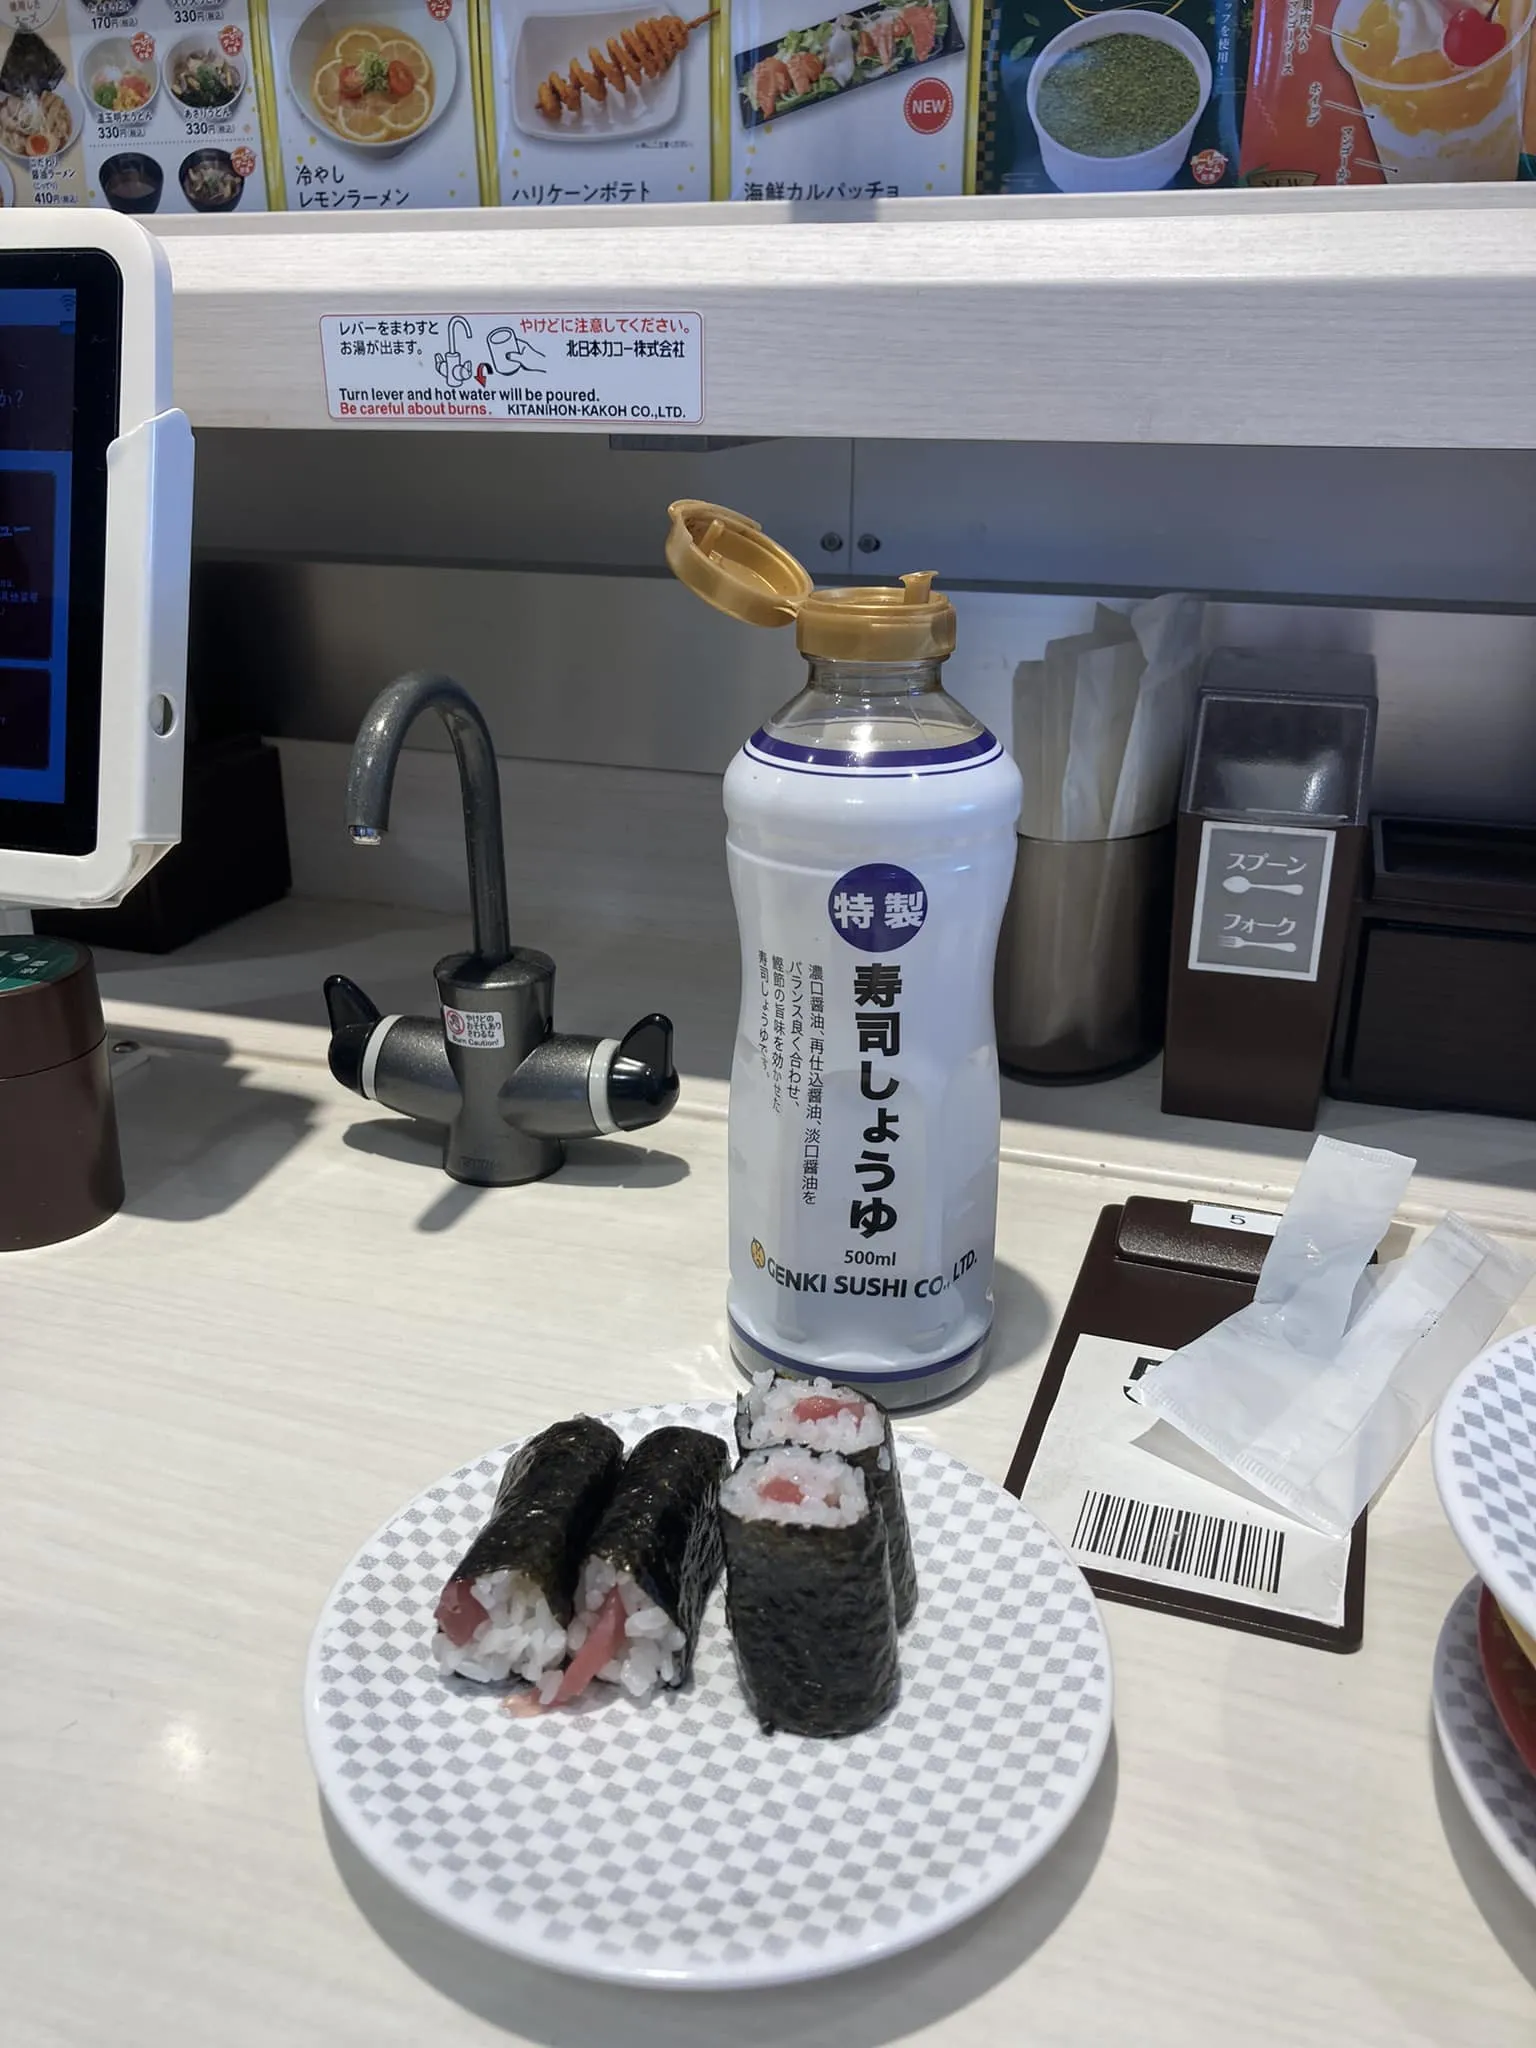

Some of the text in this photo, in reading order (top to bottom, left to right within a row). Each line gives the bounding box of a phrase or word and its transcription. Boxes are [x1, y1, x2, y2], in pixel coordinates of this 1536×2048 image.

[912, 100, 946, 115] NEW
[296, 164, 345, 187] 冷やし
[300, 188, 410, 209] レモンラーメン
[512, 180, 650, 206] ハリケーンポテト
[744, 180, 900, 201] 海鮮カルパッチョ
[339, 320, 440, 336] レバーをまわすと
[519, 317, 690, 334] やけどに注意してください。
[340, 339, 423, 356] お湯が出ます。
[566, 339, 685, 358] 北日本カコー株式会社
[339, 387, 600, 403] Turn lever and hot water will be poured.
[340, 402, 492, 416] Be careful about burns.
[507, 403, 627, 417] KITANIHON-KAKOH
[1226, 852, 1307, 876] スプーン
[833, 891, 924, 929] 特製
[1223, 913, 1297, 936] フォーク
[786, 960, 803, 1108] バランス良く合わせ、
[850, 963, 902, 1239] 寿司しょうゆ
[1230, 1214, 1246, 1225] 5
[844, 1250, 896, 1266] 500ml
[767, 1257, 827, 1293] GENKI
[833, 1275, 907, 1298] SUSHI
